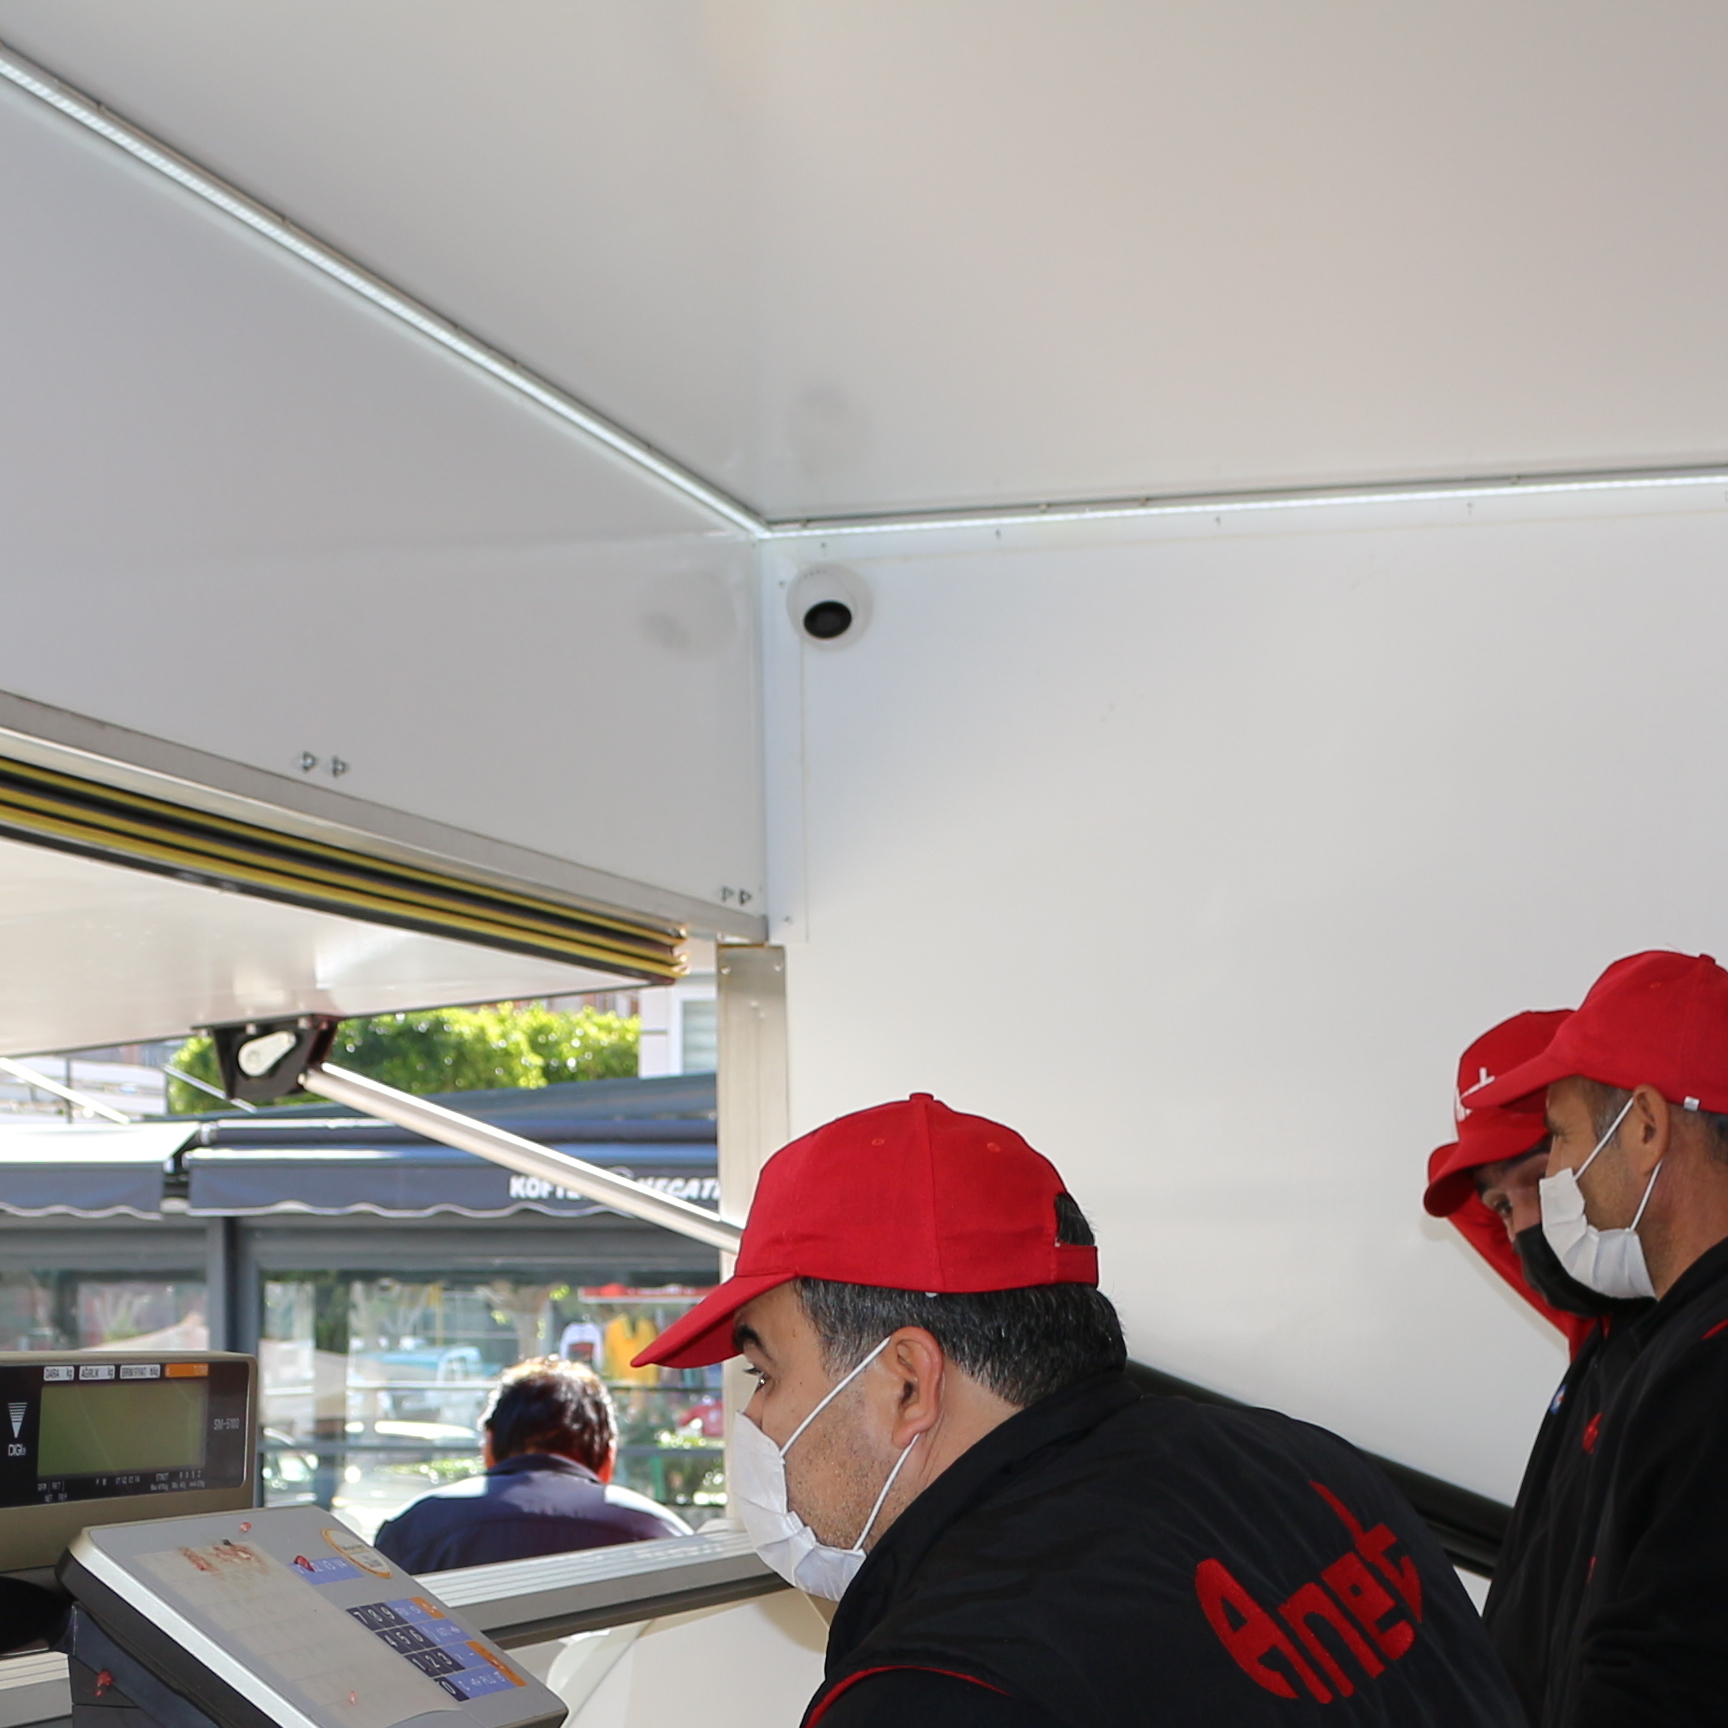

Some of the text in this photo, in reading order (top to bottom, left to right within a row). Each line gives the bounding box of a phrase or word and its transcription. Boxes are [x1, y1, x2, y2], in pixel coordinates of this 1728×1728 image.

[213, 1418, 240, 1430] SM-5100
[1195, 1480, 1422, 1705] Anet
[353, 1611, 369, 1625] 7
[382, 1606, 395, 1620] 9
[384, 1629, 424, 1648] 4 5 6
[425, 1654, 440, 1669] 2
[438, 1652, 452, 1665] 3
